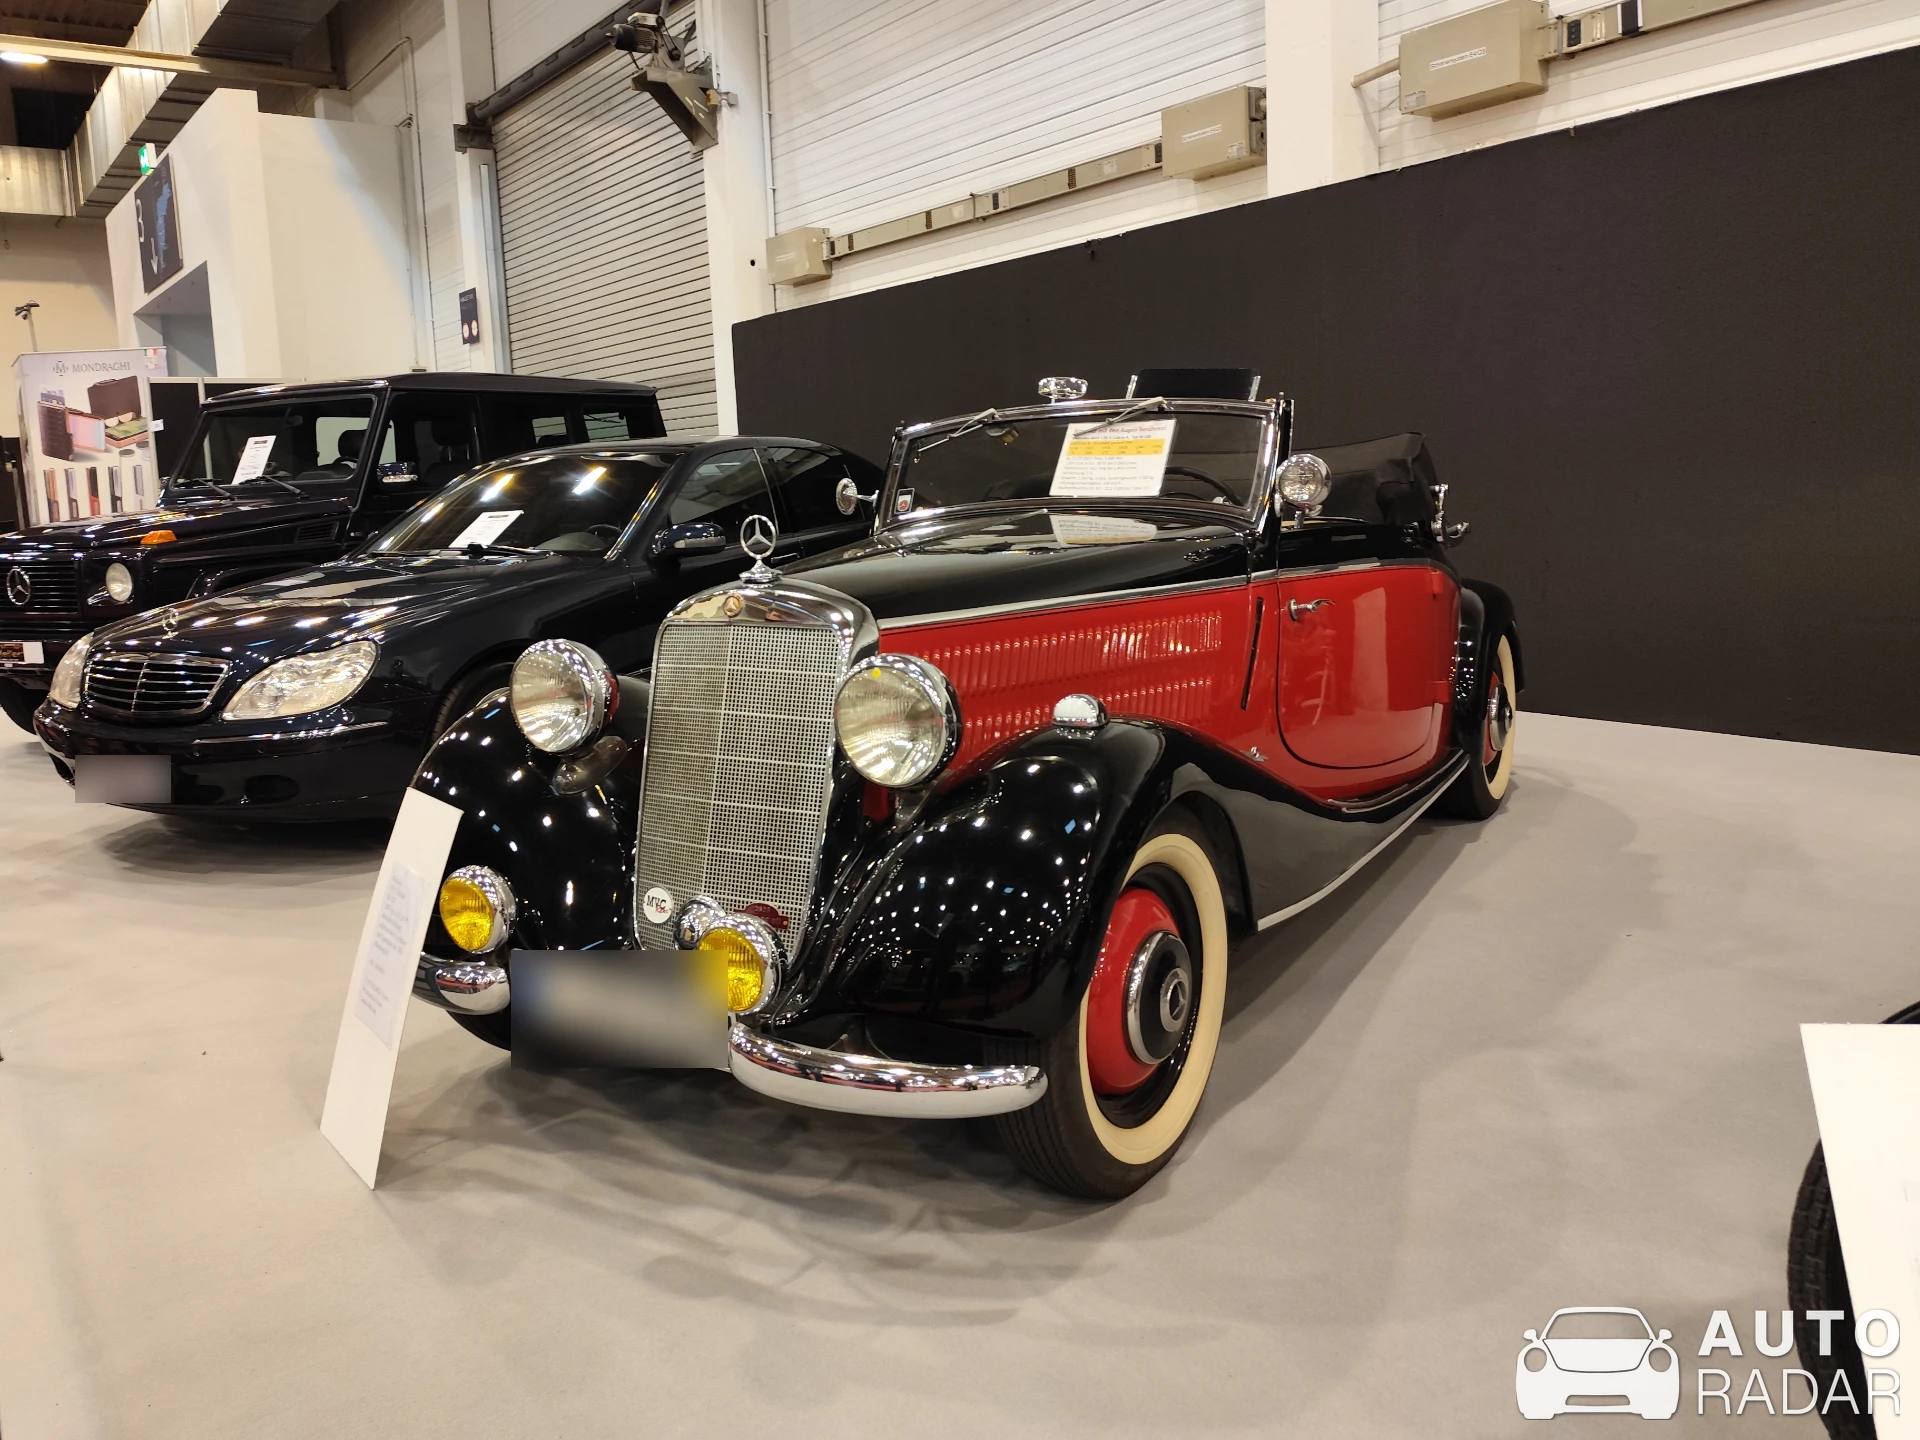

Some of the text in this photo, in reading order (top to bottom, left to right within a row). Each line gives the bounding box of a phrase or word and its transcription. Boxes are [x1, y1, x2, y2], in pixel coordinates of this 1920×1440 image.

[135, 199, 145, 243] 3
[72, 361, 131, 373] MONDRAGHI
[647, 895, 667, 909] MVC
